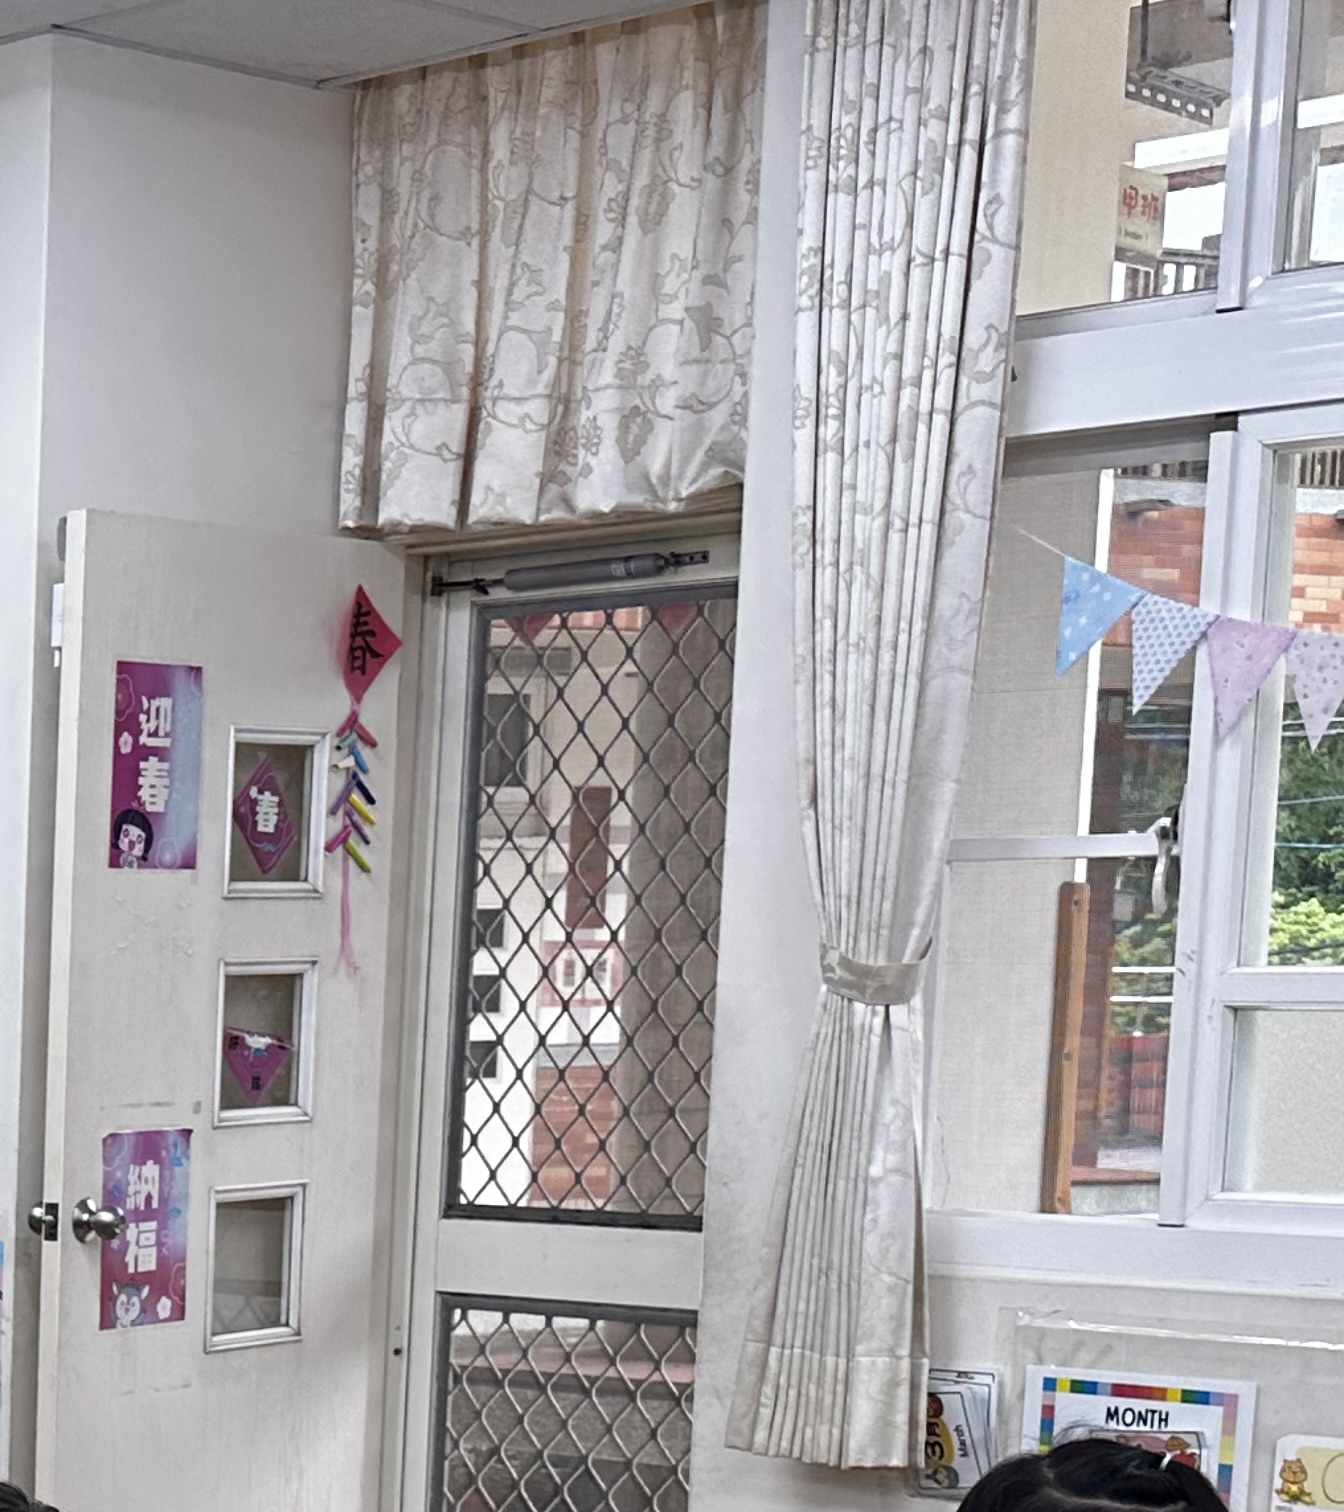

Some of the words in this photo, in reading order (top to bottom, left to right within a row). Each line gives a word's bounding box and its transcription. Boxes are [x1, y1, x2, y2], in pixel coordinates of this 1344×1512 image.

[350, 600, 385, 677] 春
[137, 695, 174, 813] 迎春
[255, 790, 280, 834] 春
[125, 1160, 160, 1274] 納福
[1105, 1405, 1169, 1430] MONTH
